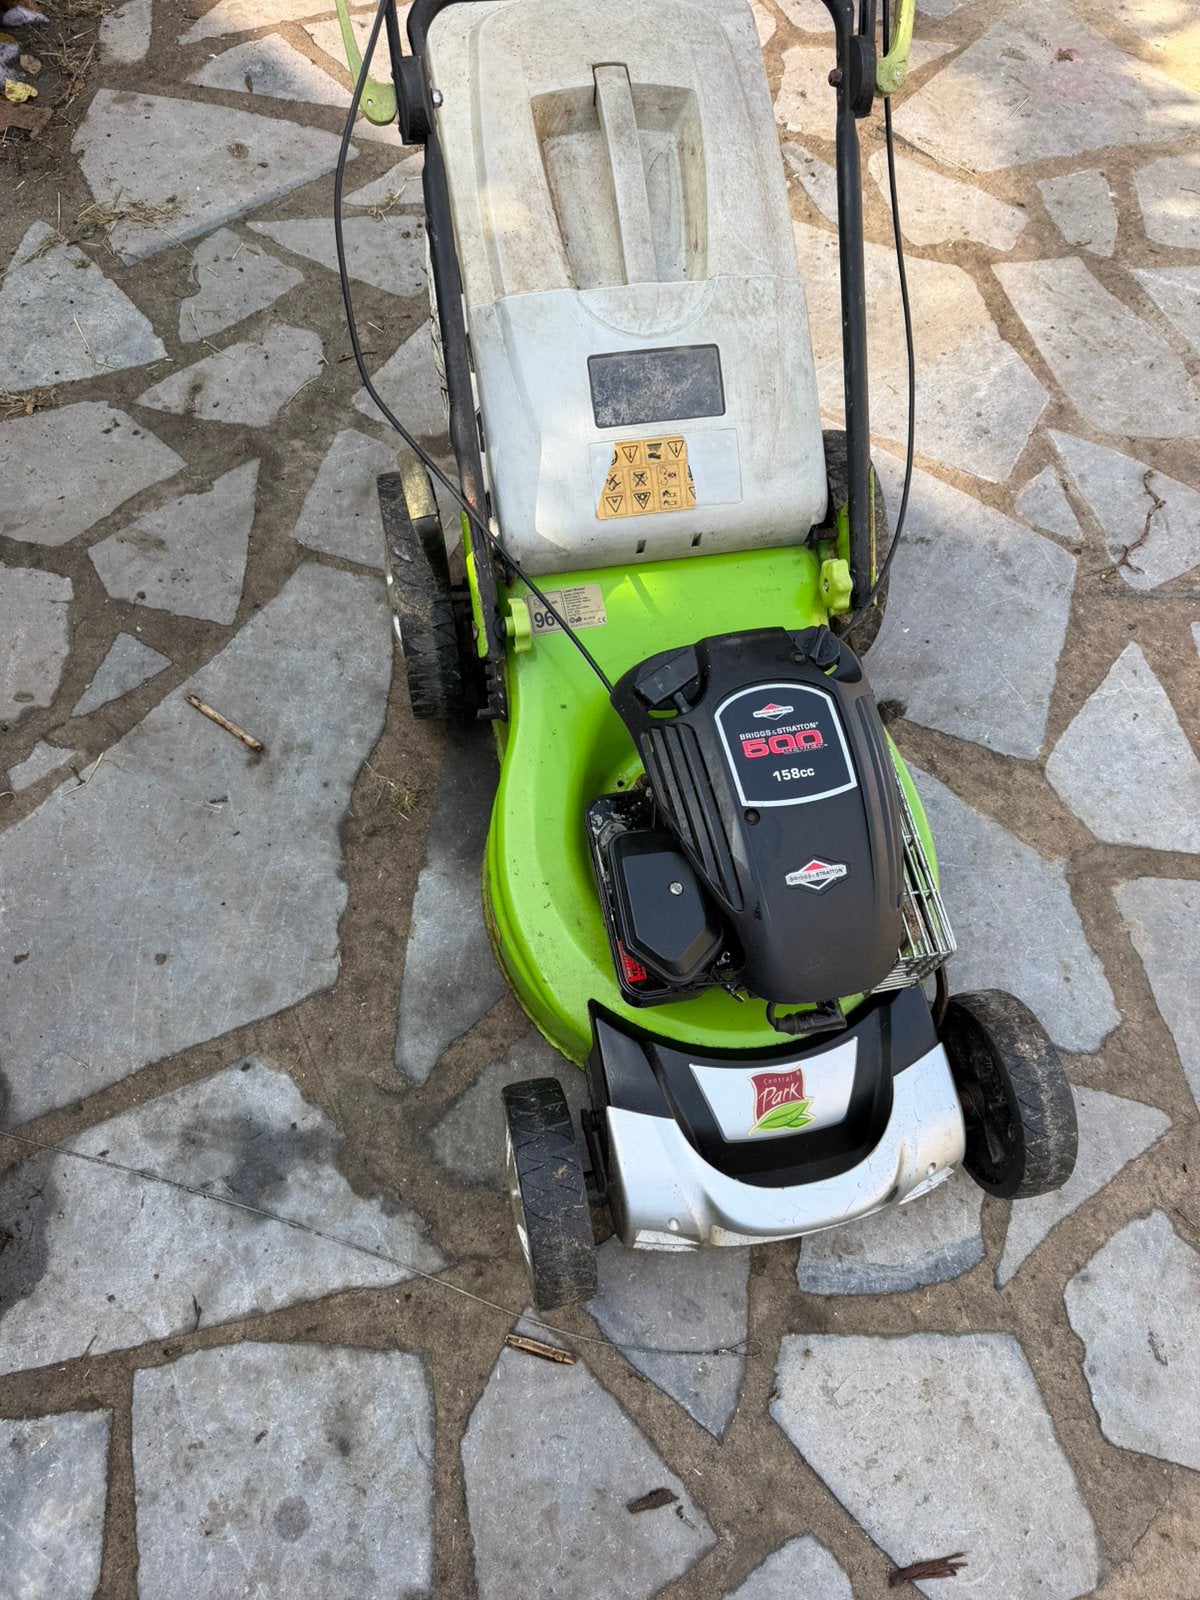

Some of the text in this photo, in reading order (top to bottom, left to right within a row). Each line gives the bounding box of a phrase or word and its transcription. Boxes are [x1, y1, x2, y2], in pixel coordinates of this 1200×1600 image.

[741, 729, 824, 759] 500
[772, 767, 815, 782] 158cc
[763, 1074, 793, 1085] Central
[759, 1081, 802, 1112] Park
